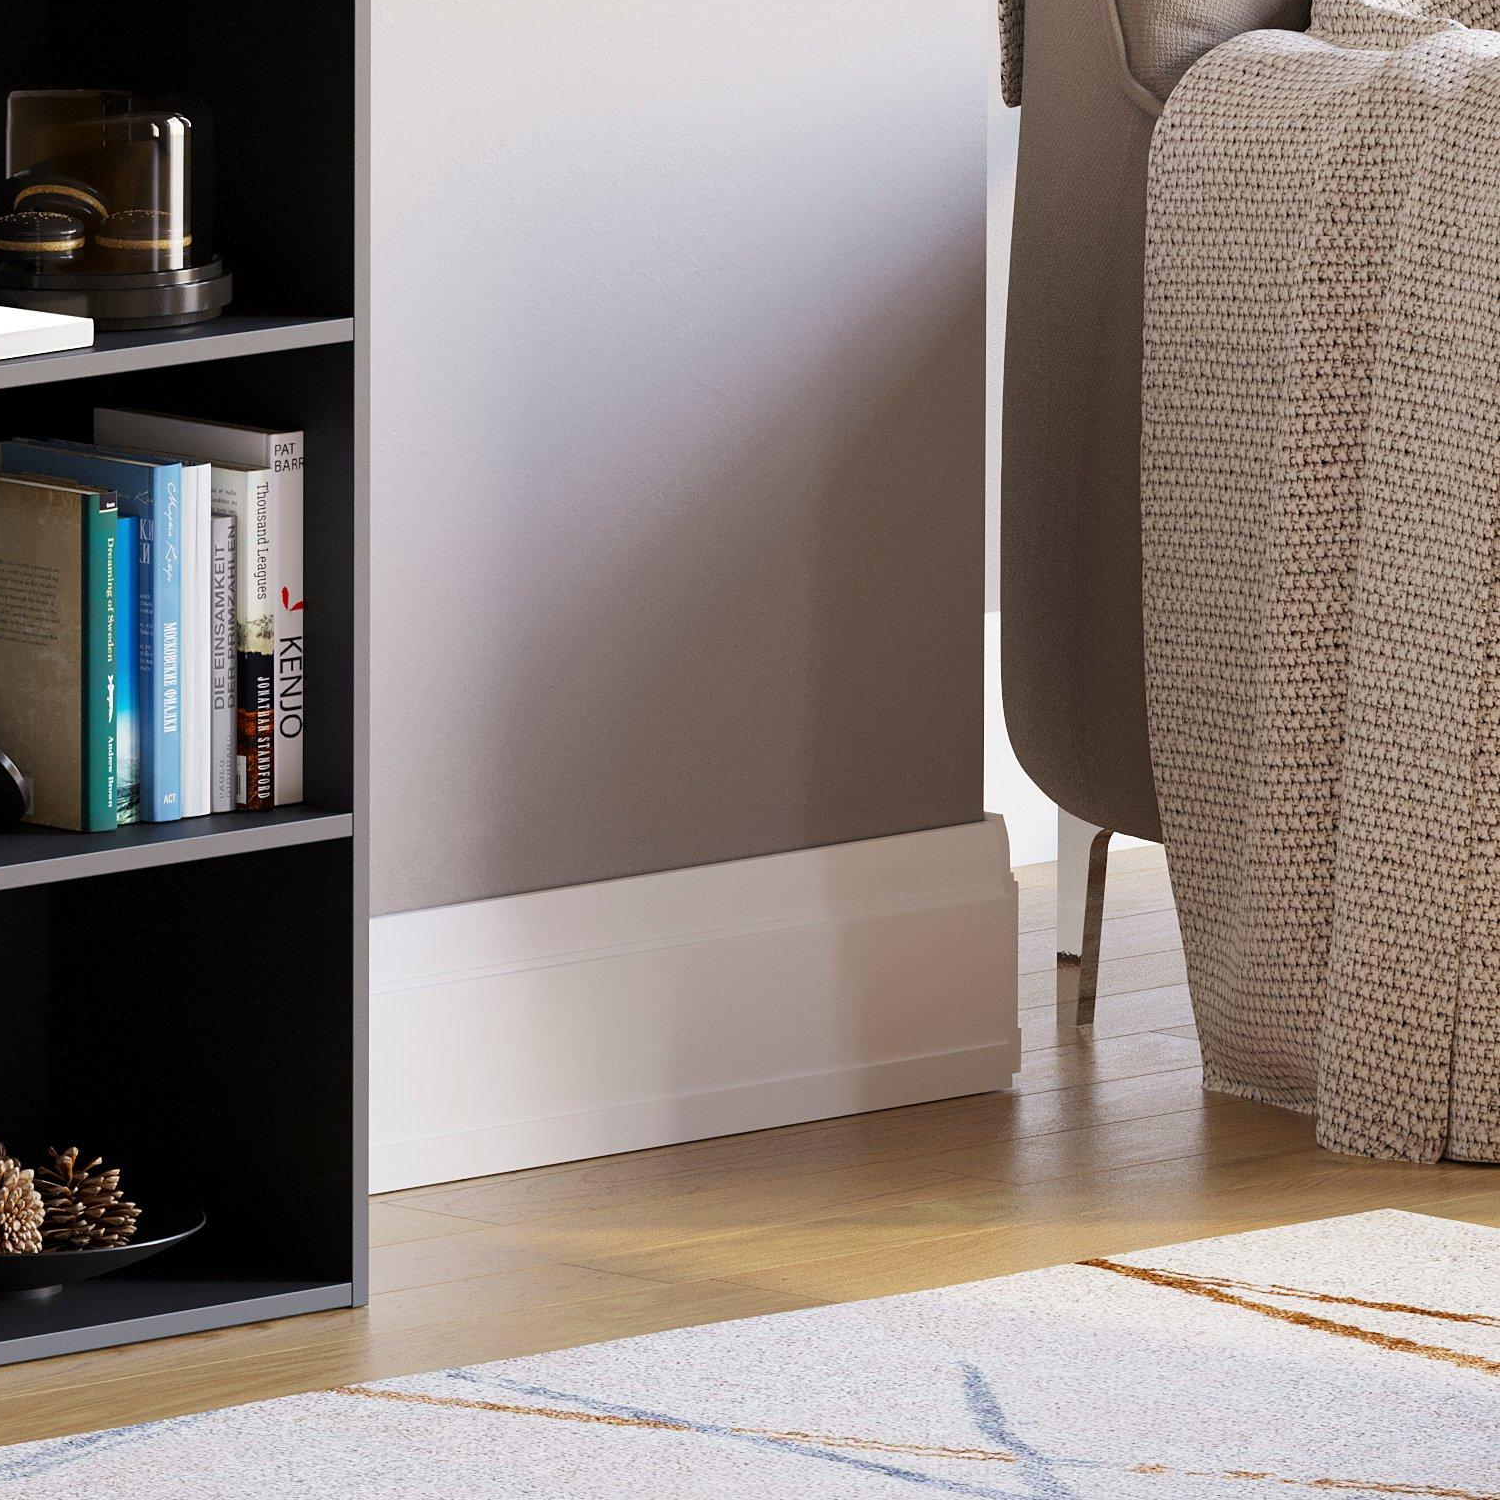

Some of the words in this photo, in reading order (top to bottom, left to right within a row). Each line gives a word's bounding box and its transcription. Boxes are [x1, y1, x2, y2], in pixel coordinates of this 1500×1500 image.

[274, 442, 296, 456] PAT
[256, 481, 270, 545] Thousand
[105, 537, 115, 598] Dreaming
[253, 547, 269, 600] Leagues
[107, 599, 114, 612] of
[214, 543, 225, 670] EINSAMKEIT
[107, 614, 115, 662] Sweden
[214, 676, 225, 710] DIE
[227, 666, 237, 709] DER
[257, 676, 271, 732] JONATHAN
[279, 636, 303, 738] KENJO
[257, 736, 271, 799] STANDFORD
